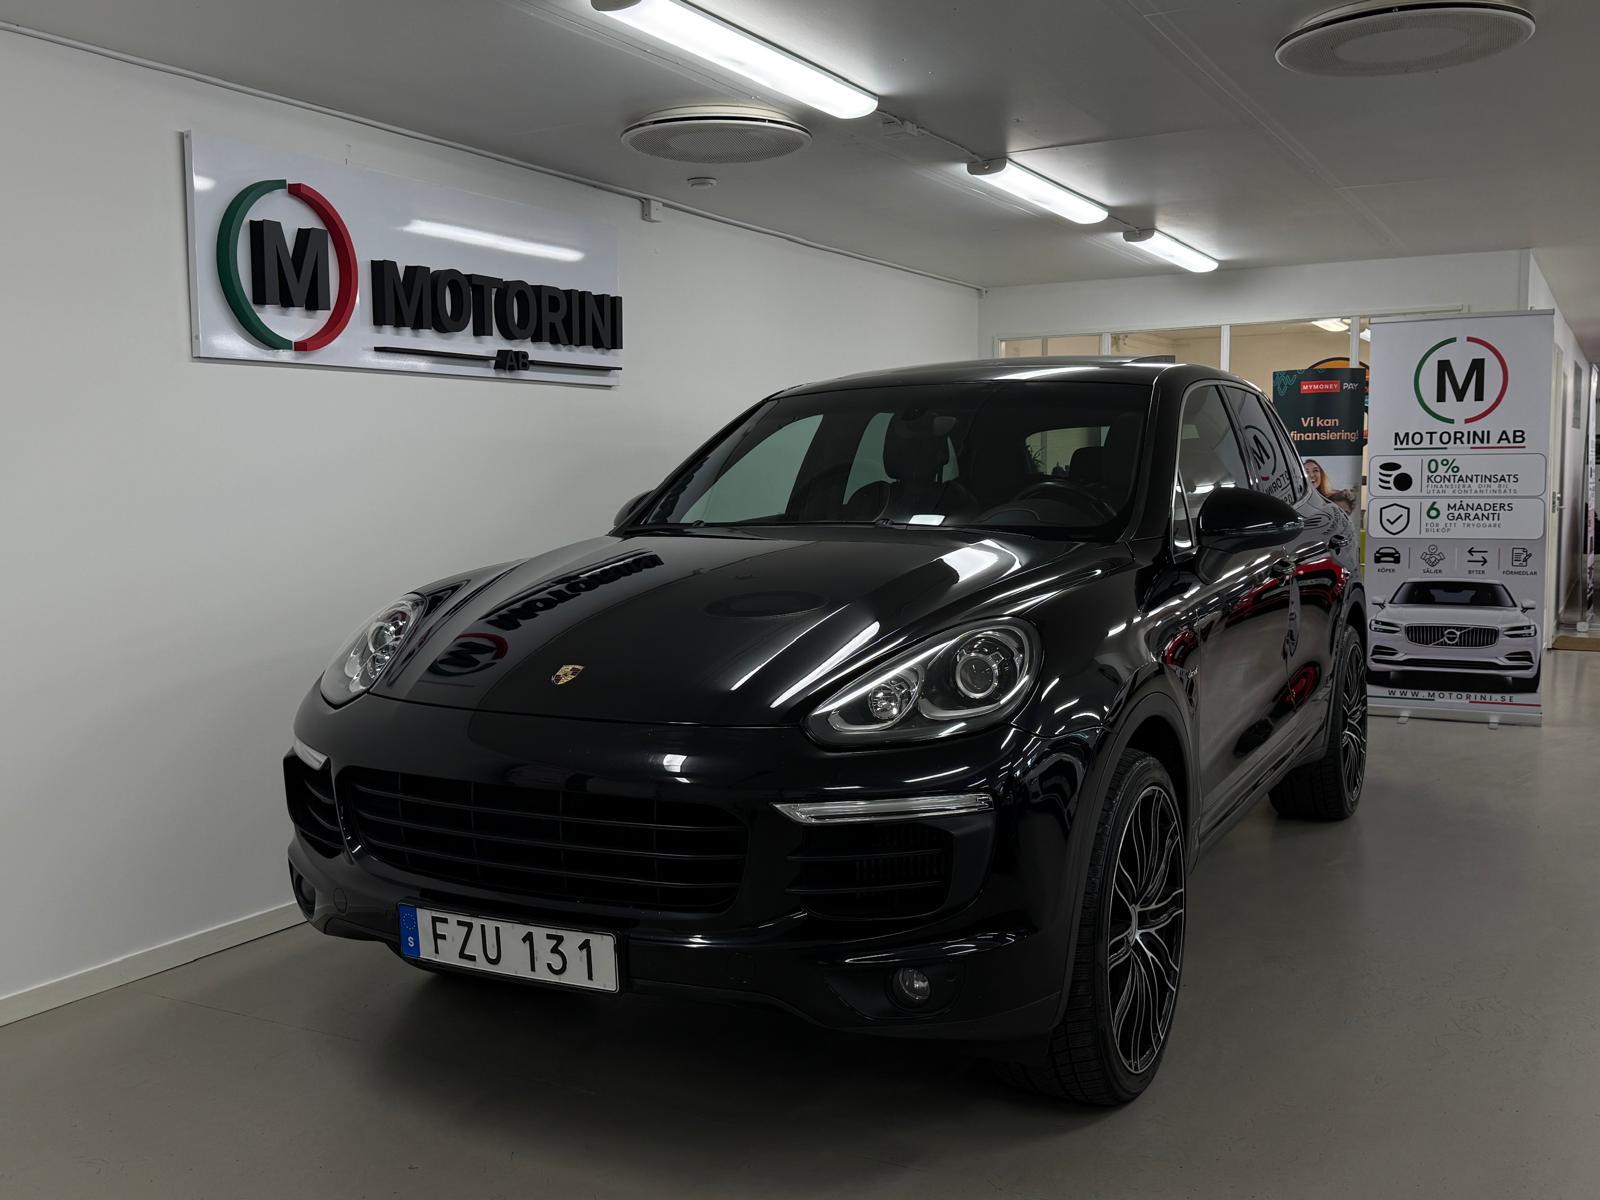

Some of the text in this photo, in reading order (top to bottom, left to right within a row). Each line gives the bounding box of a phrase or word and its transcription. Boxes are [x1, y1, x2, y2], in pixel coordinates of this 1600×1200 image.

[249, 219, 331, 311] M
[371, 259, 623, 350] MOTORINI
[495, 350, 530, 371] AB
[1342, 382, 1359, 390] PAY
[1436, 358, 1485, 403] M
[1301, 416, 1339, 427] Vi kan
[1290, 429, 1359, 442] finansiering!
[1394, 429, 1526, 446] MOTORINI AB
[1427, 458, 1460, 474] 0%
[1426, 473, 1519, 484] KONTANTINSATS
[1426, 500, 1514, 520] 6 MÅNADERS
[1446, 512, 1501, 521] GARANTI
[1387, 689, 1515, 703] WWW.MOTORINI.SE
[407, 936, 415, 948] S
[431, 916, 594, 982] FZU 131
